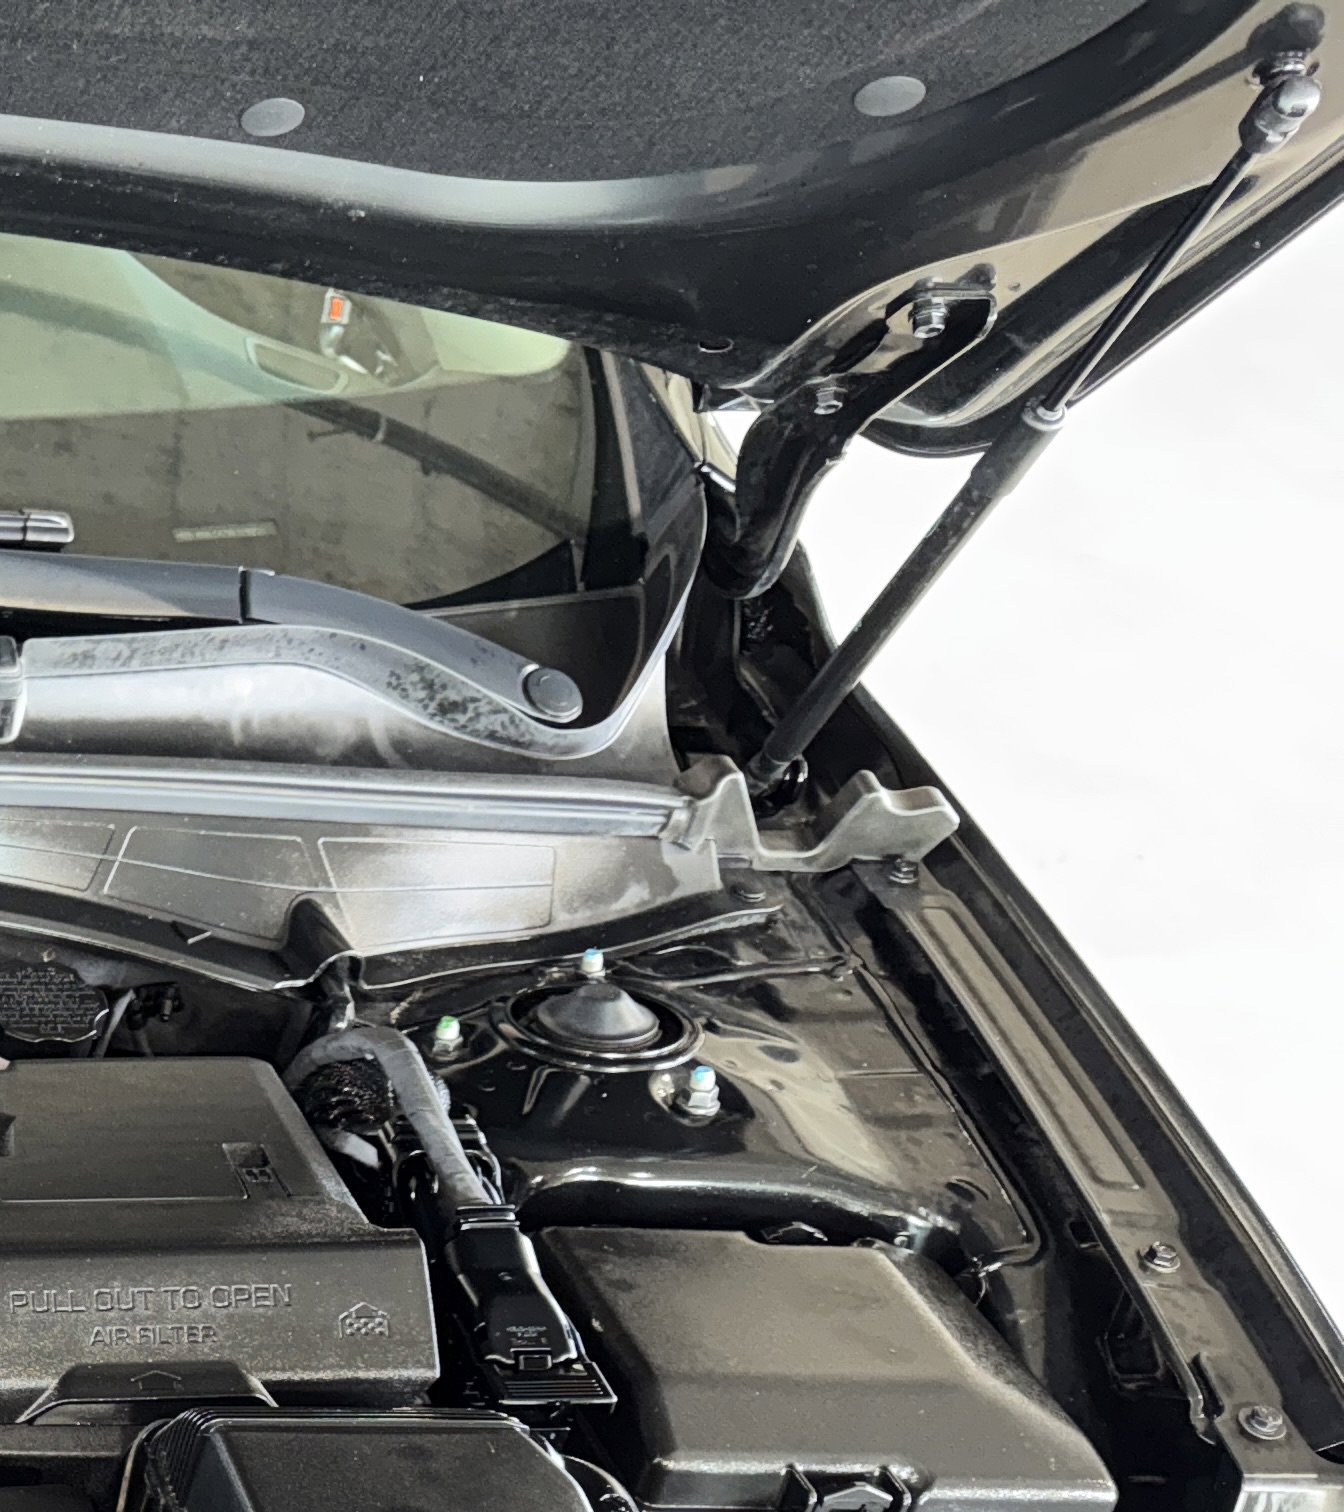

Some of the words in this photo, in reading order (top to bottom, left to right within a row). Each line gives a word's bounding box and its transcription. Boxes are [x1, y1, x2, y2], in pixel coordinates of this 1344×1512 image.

[10, 1290, 86, 1313] PULL
[93, 1287, 154, 1312] OUT
[161, 1286, 202, 1311] TO
[210, 1283, 293, 1310] OPEN
[89, 1325, 130, 1347] AIR
[135, 1325, 218, 1346] FILTER
